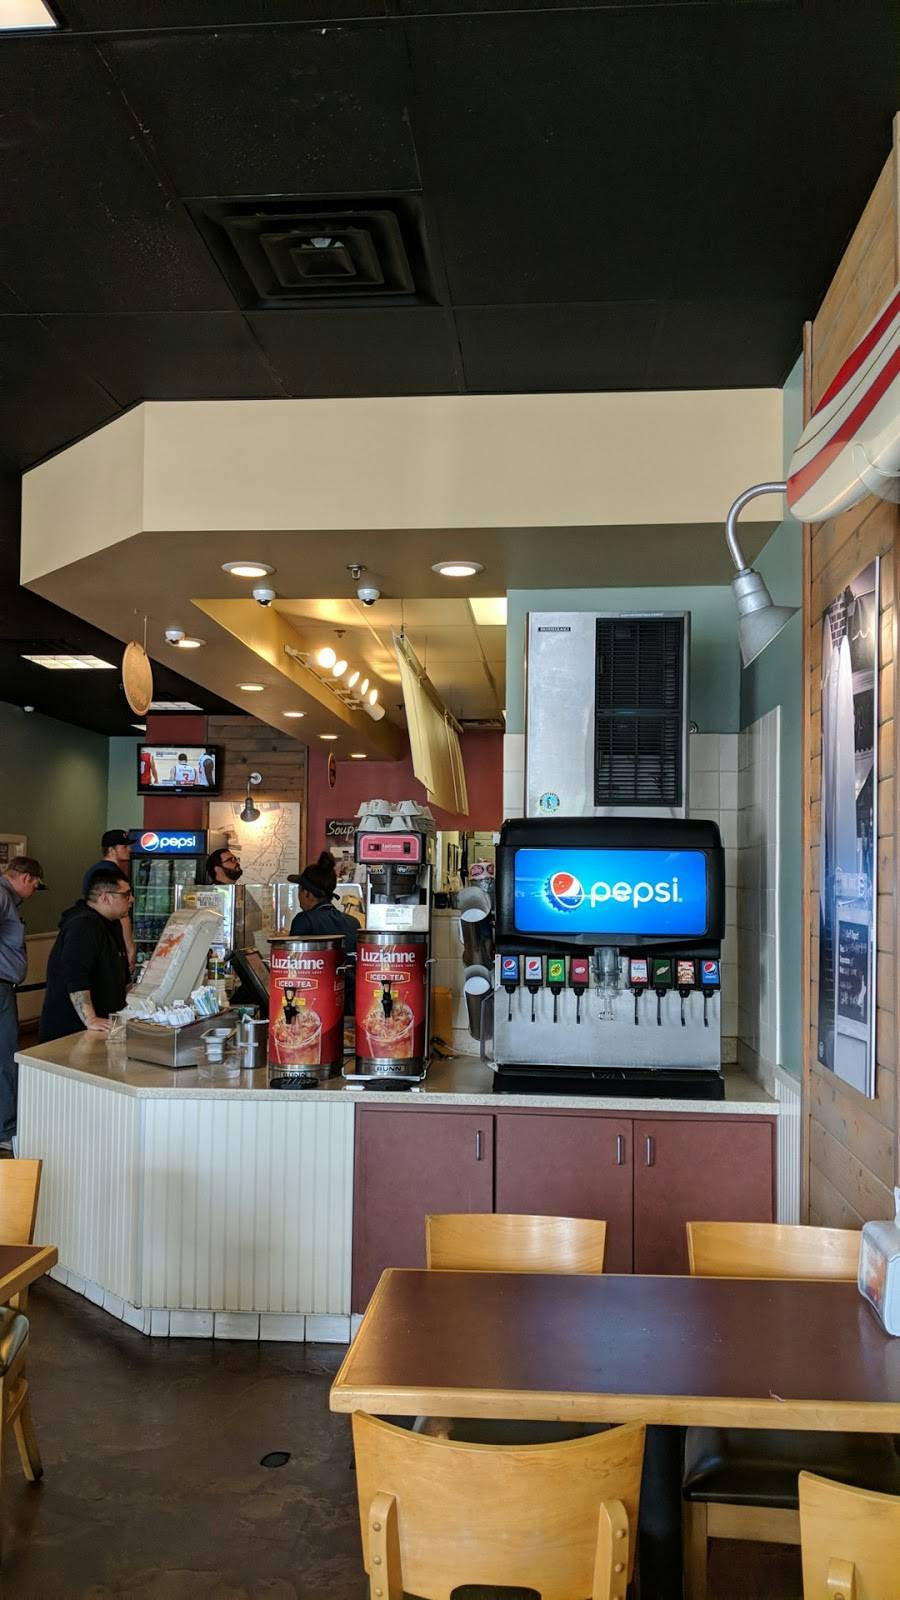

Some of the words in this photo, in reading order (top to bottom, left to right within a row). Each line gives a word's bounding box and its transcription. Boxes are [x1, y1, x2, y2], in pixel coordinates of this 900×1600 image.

[160, 836, 196, 848] pepsi
[590, 877, 680, 909] pepsi
[271, 954, 325, 970] Luzianne
[361, 948, 415, 963] Luzianne
[370, 973, 387, 981] ICED
